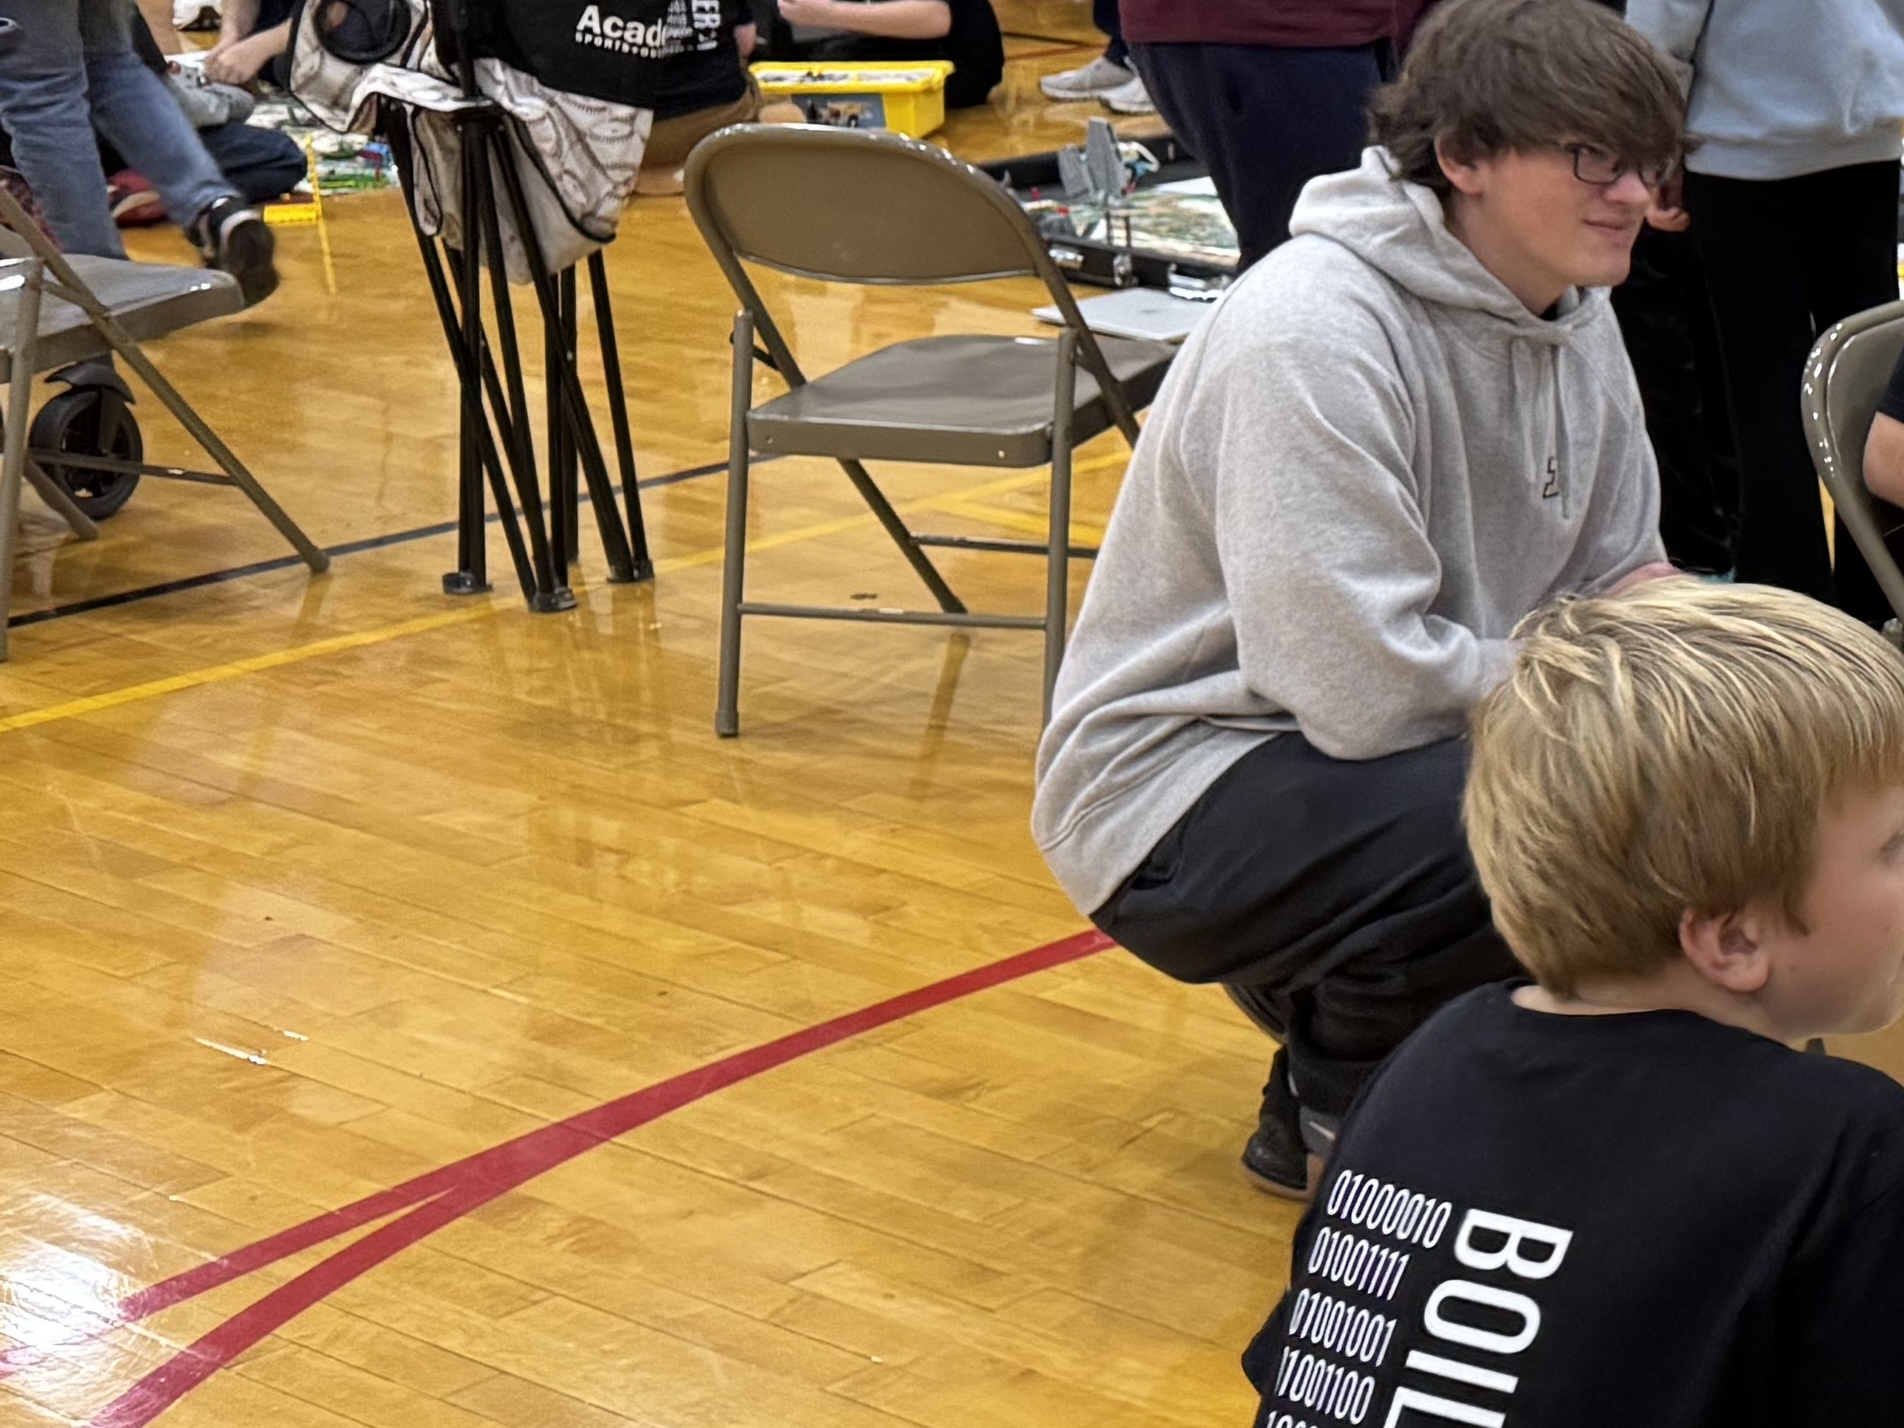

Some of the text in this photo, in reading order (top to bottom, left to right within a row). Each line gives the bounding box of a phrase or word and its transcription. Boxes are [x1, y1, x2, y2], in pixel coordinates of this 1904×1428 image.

[1326, 1169, 1452, 1249] 01000010
[1307, 1226, 1411, 1301] 01001111
[1288, 1287, 1398, 1368] 01001001
